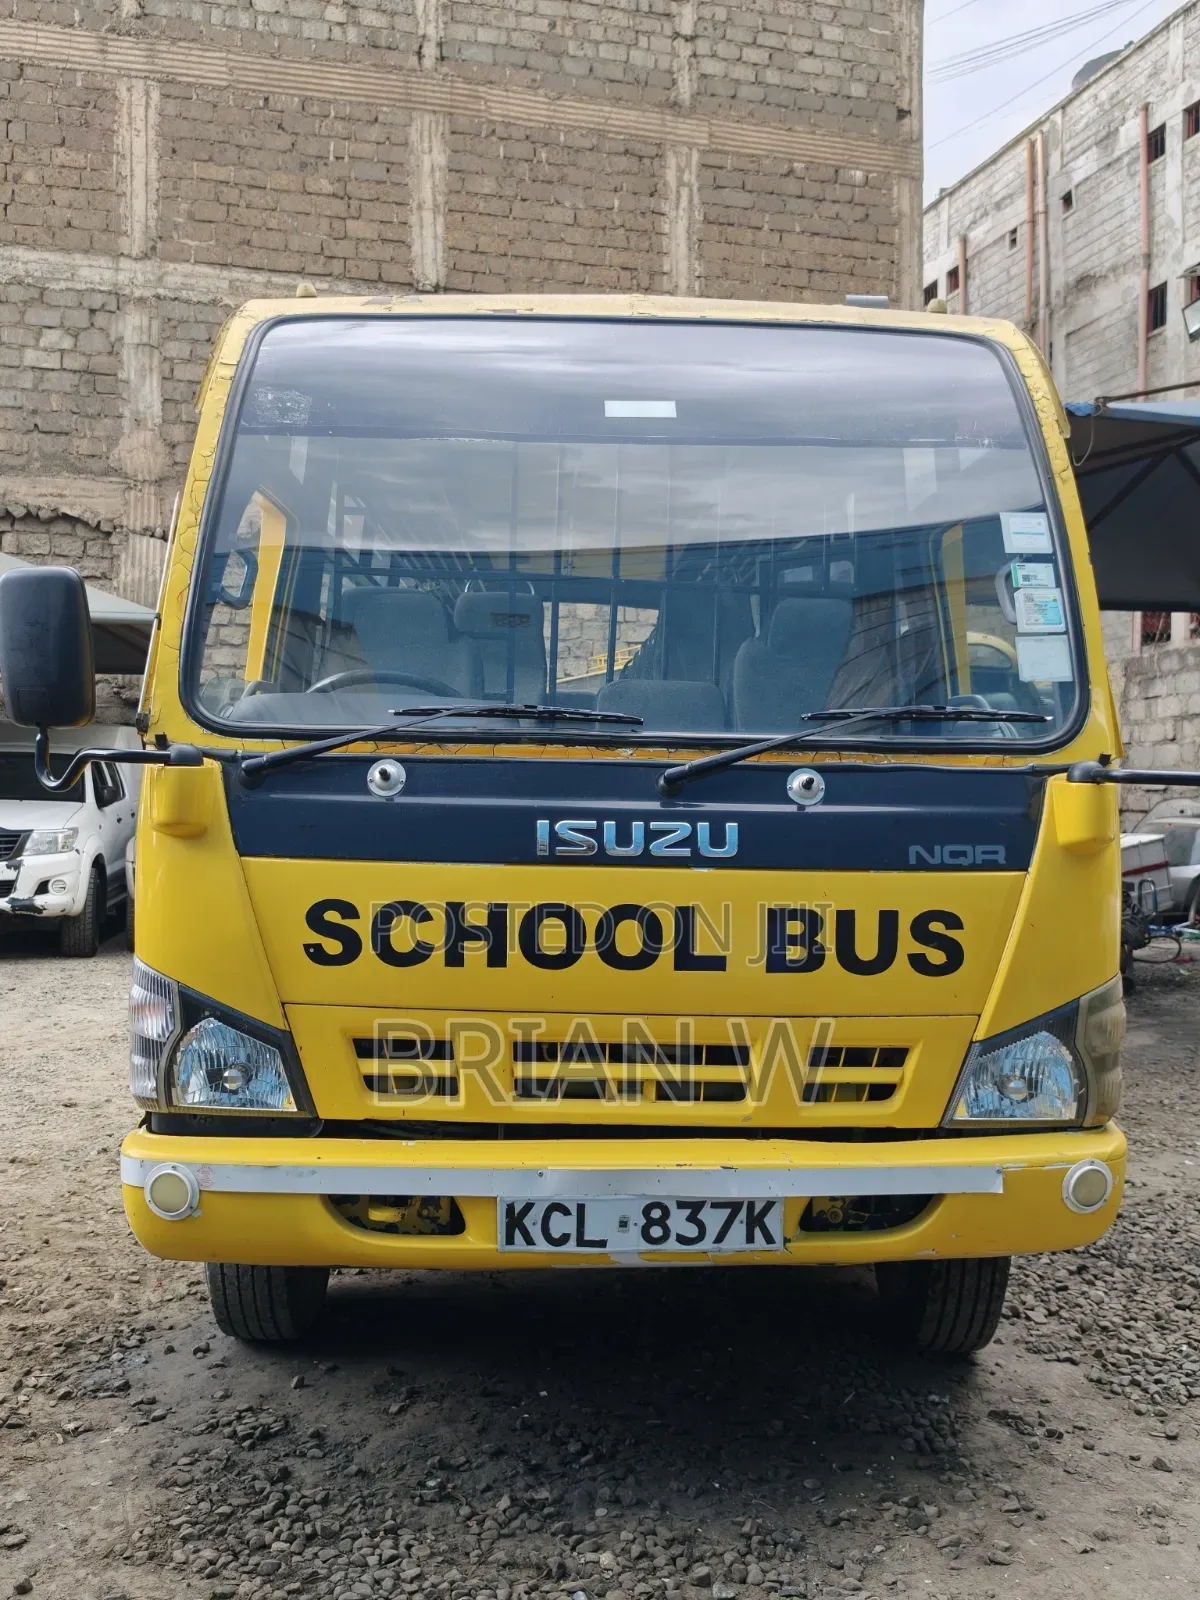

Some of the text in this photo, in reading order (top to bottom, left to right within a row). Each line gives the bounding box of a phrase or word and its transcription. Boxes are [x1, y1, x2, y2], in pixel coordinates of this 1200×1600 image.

[537, 820, 739, 858] ISUZU
[908, 844, 1007, 866] NQR
[303, 899, 965, 978] SCHOOL BUS
[505, 1202, 609, 1249] KCL
[640, 1200, 778, 1247] 837K
